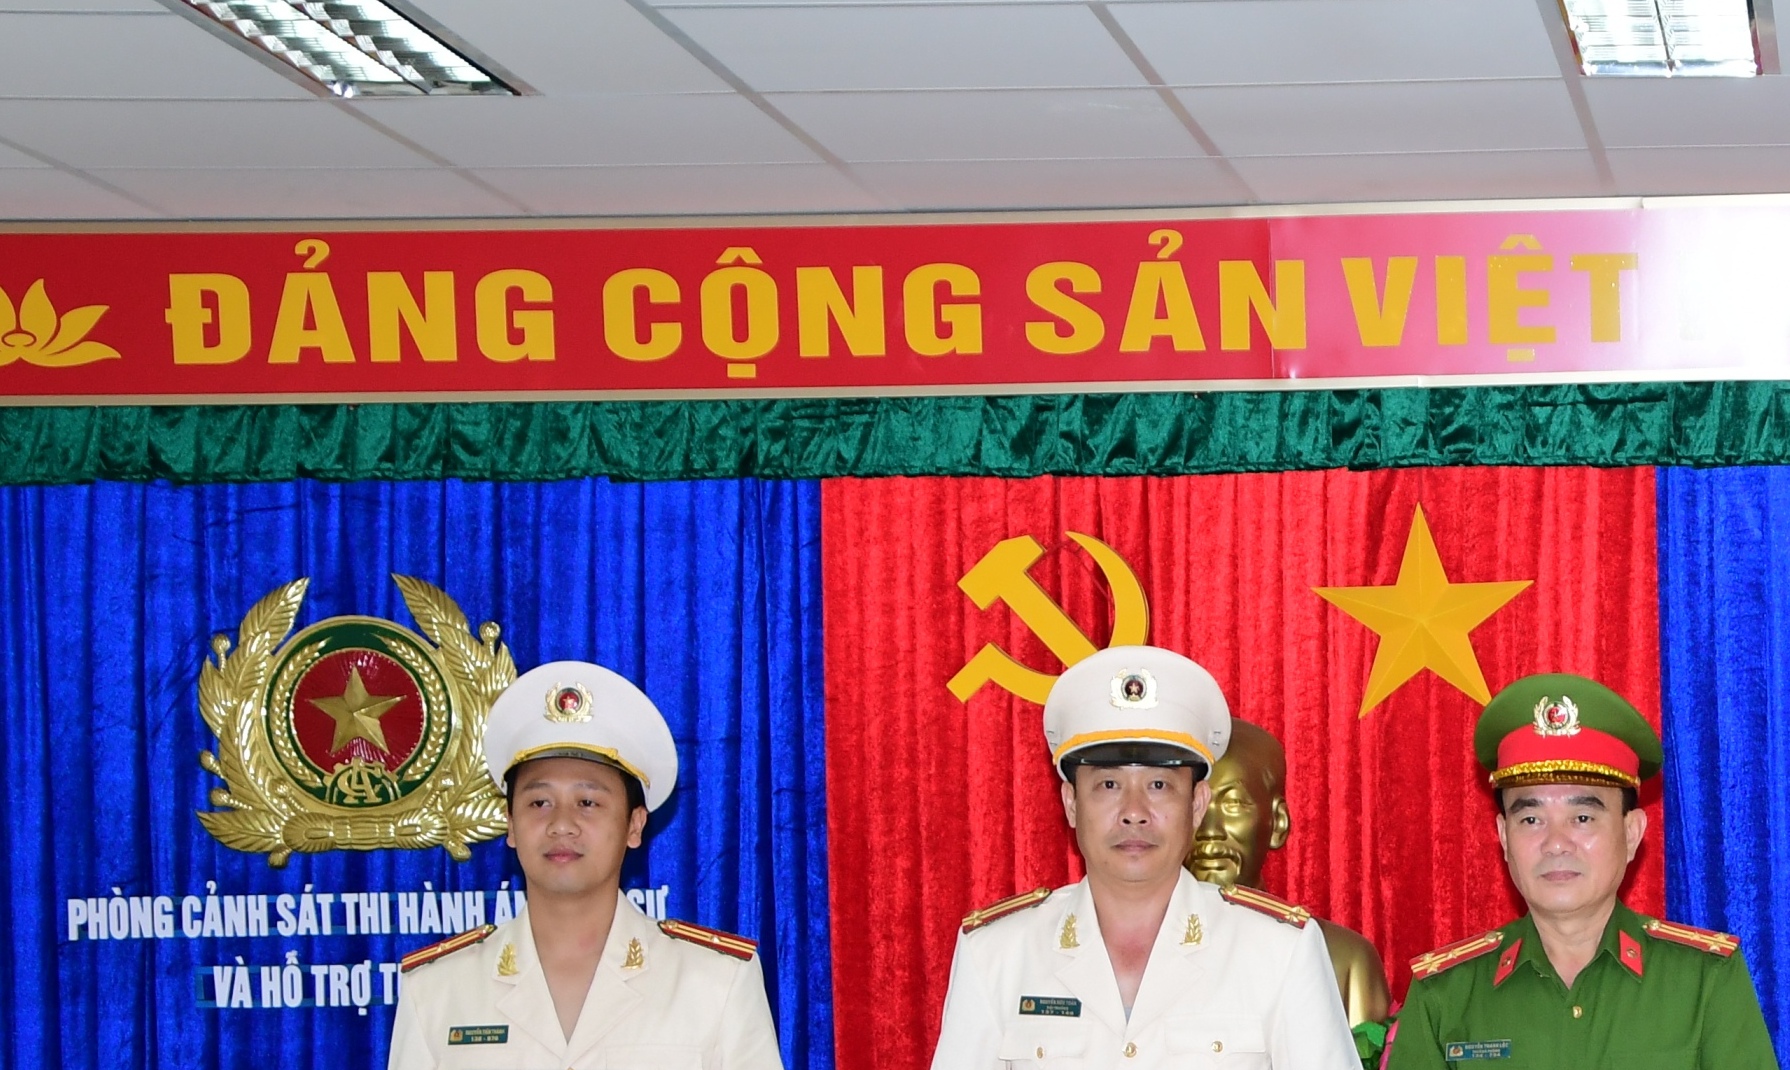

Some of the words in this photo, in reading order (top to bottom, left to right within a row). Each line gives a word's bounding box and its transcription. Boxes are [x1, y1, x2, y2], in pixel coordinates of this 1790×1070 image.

[165, 239, 556, 364] ĐẢNG
[602, 246, 983, 379] CỘNG
[1025, 229, 1307, 355] SẢN
[1341, 234, 1639, 363] VIỆT
[67, 886, 174, 941] PHÒNG
[181, 880, 269, 938] CẢNH
[275, 883, 334, 937] SÁT
[340, 891, 392, 935] THI
[399, 881, 485, 935] HÀNH
[213, 955, 253, 1008] VÀ
[260, 949, 303, 1009] HỖ
[310, 959, 373, 1016] TRỢ
